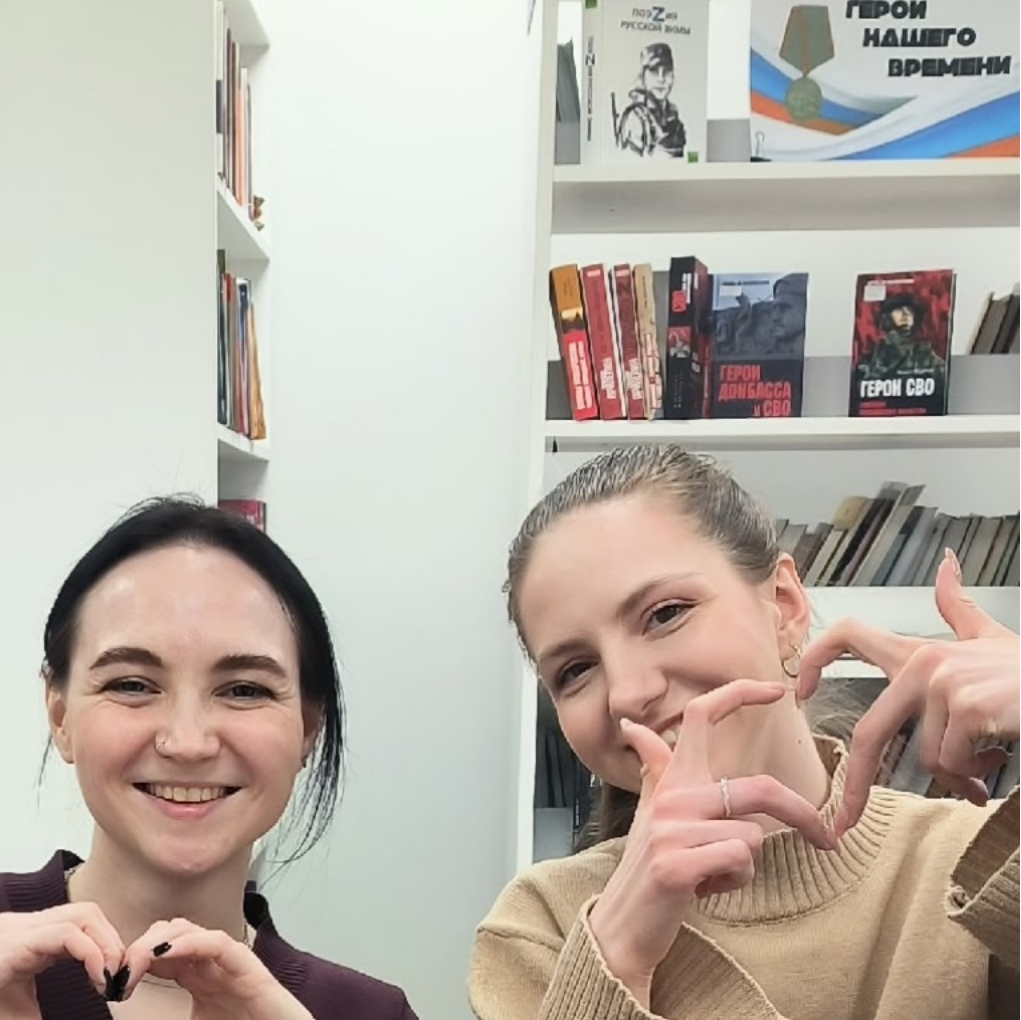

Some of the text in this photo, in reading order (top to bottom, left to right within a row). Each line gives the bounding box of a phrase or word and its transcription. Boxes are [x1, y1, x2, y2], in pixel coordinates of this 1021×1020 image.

[846, 0, 927, 19] ГЕРОИ
[863, 27, 976, 47] НАШЕГО
[888, 56, 1012, 77] ВРЕМЕНИ
[720, 364, 761, 381] ГЕРОИ
[718, 381, 792, 402] ДОНБАССА
[860, 377, 935, 398] ГЕРОИ СВО
[763, 400, 792, 417] СВО
